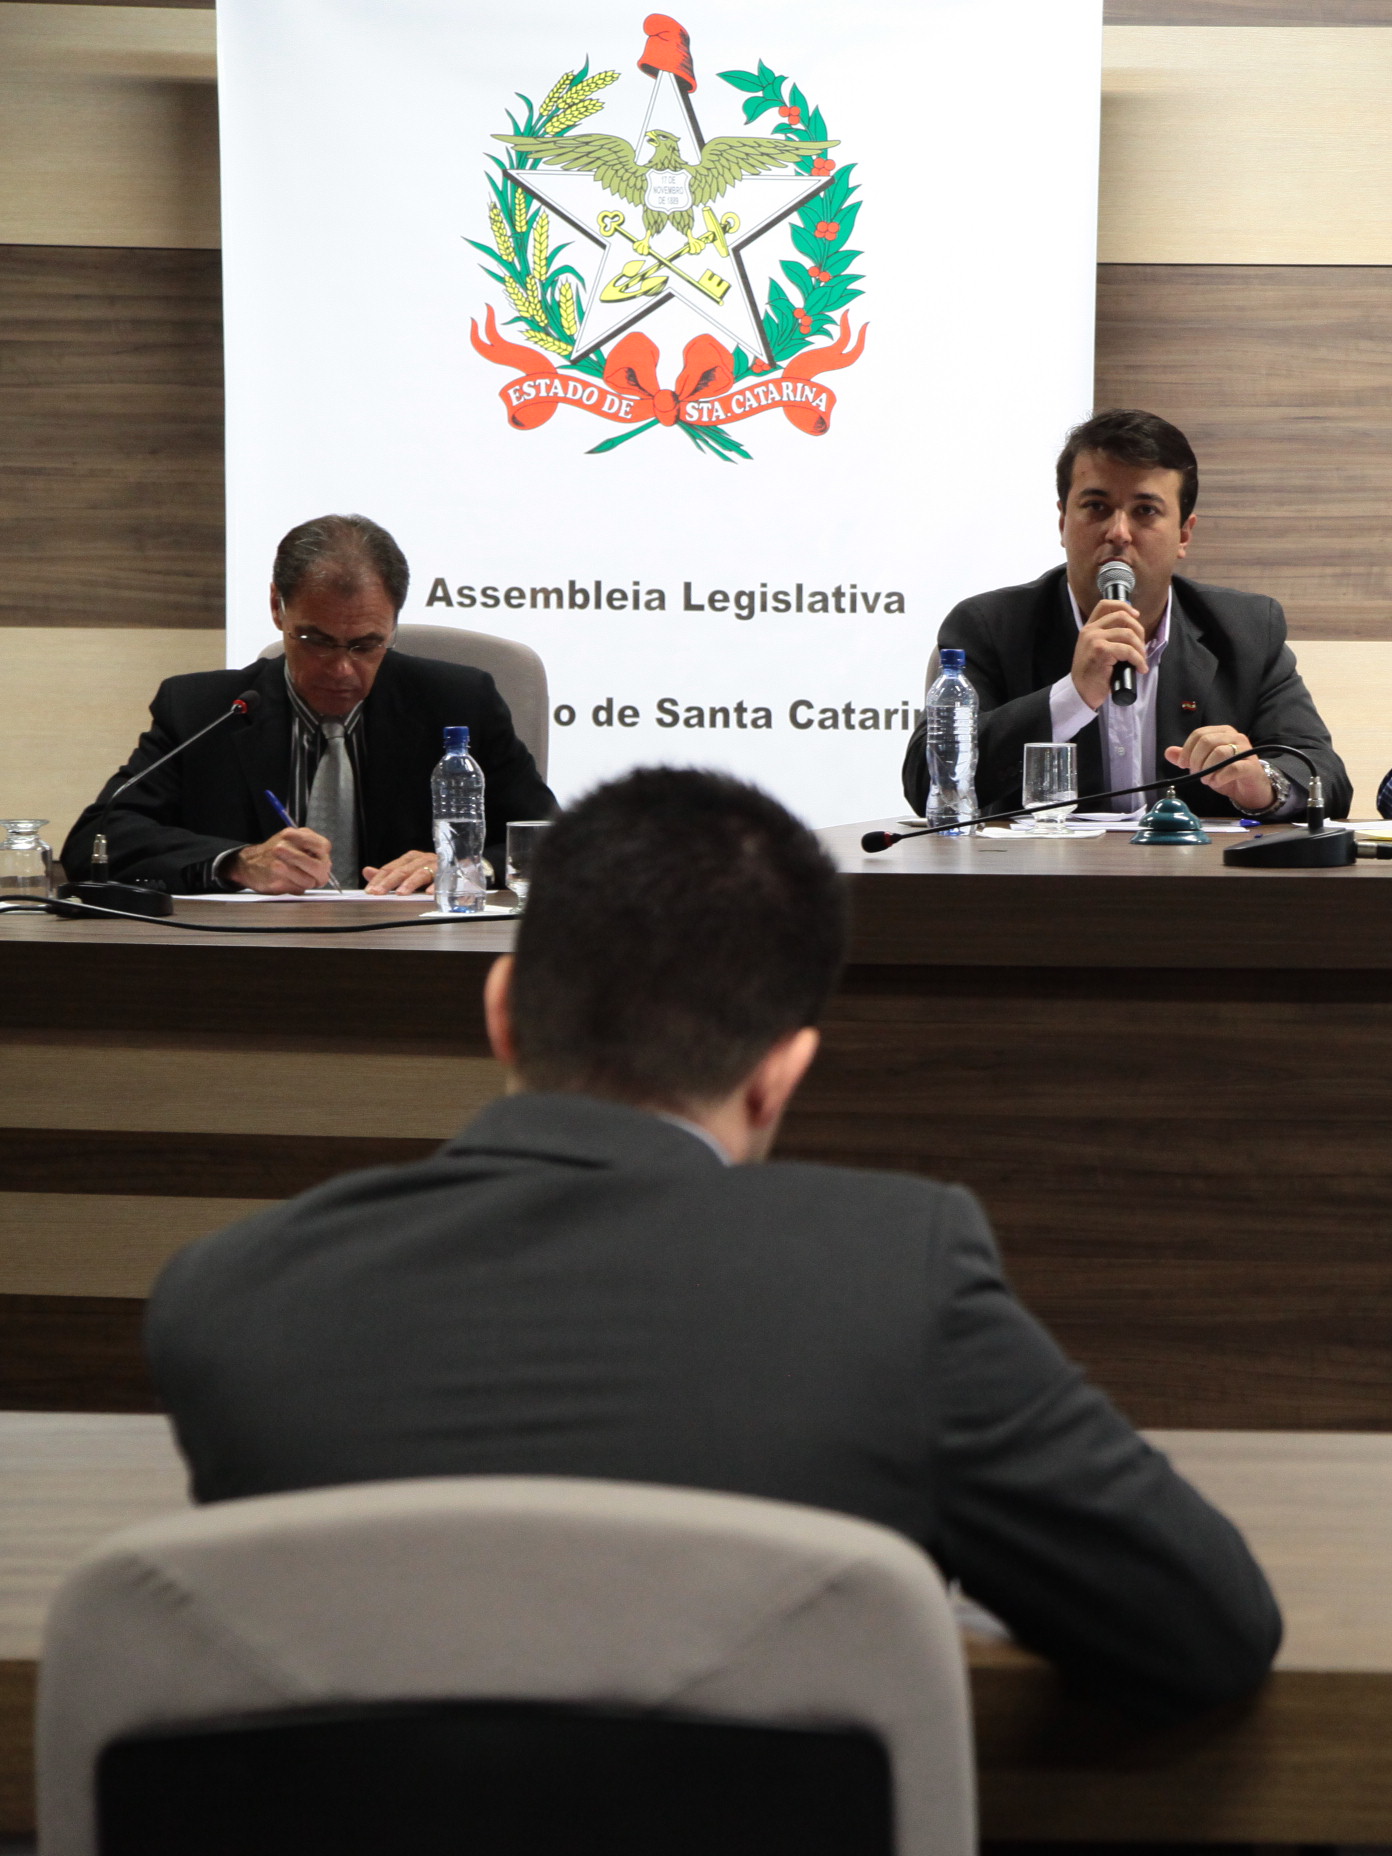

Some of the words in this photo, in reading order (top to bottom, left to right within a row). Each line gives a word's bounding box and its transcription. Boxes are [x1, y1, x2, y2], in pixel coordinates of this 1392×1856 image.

[508, 379, 599, 406] ESTADO
[601, 395, 634, 419] DE
[685, 401, 731, 421] STA.
[731, 382, 827, 412] CATARINA
[426, 578, 666, 610] Assembleia
[684, 581, 905, 621] Legislativa
[592, 698, 639, 728] de
[656, 698, 773, 730] Santa
